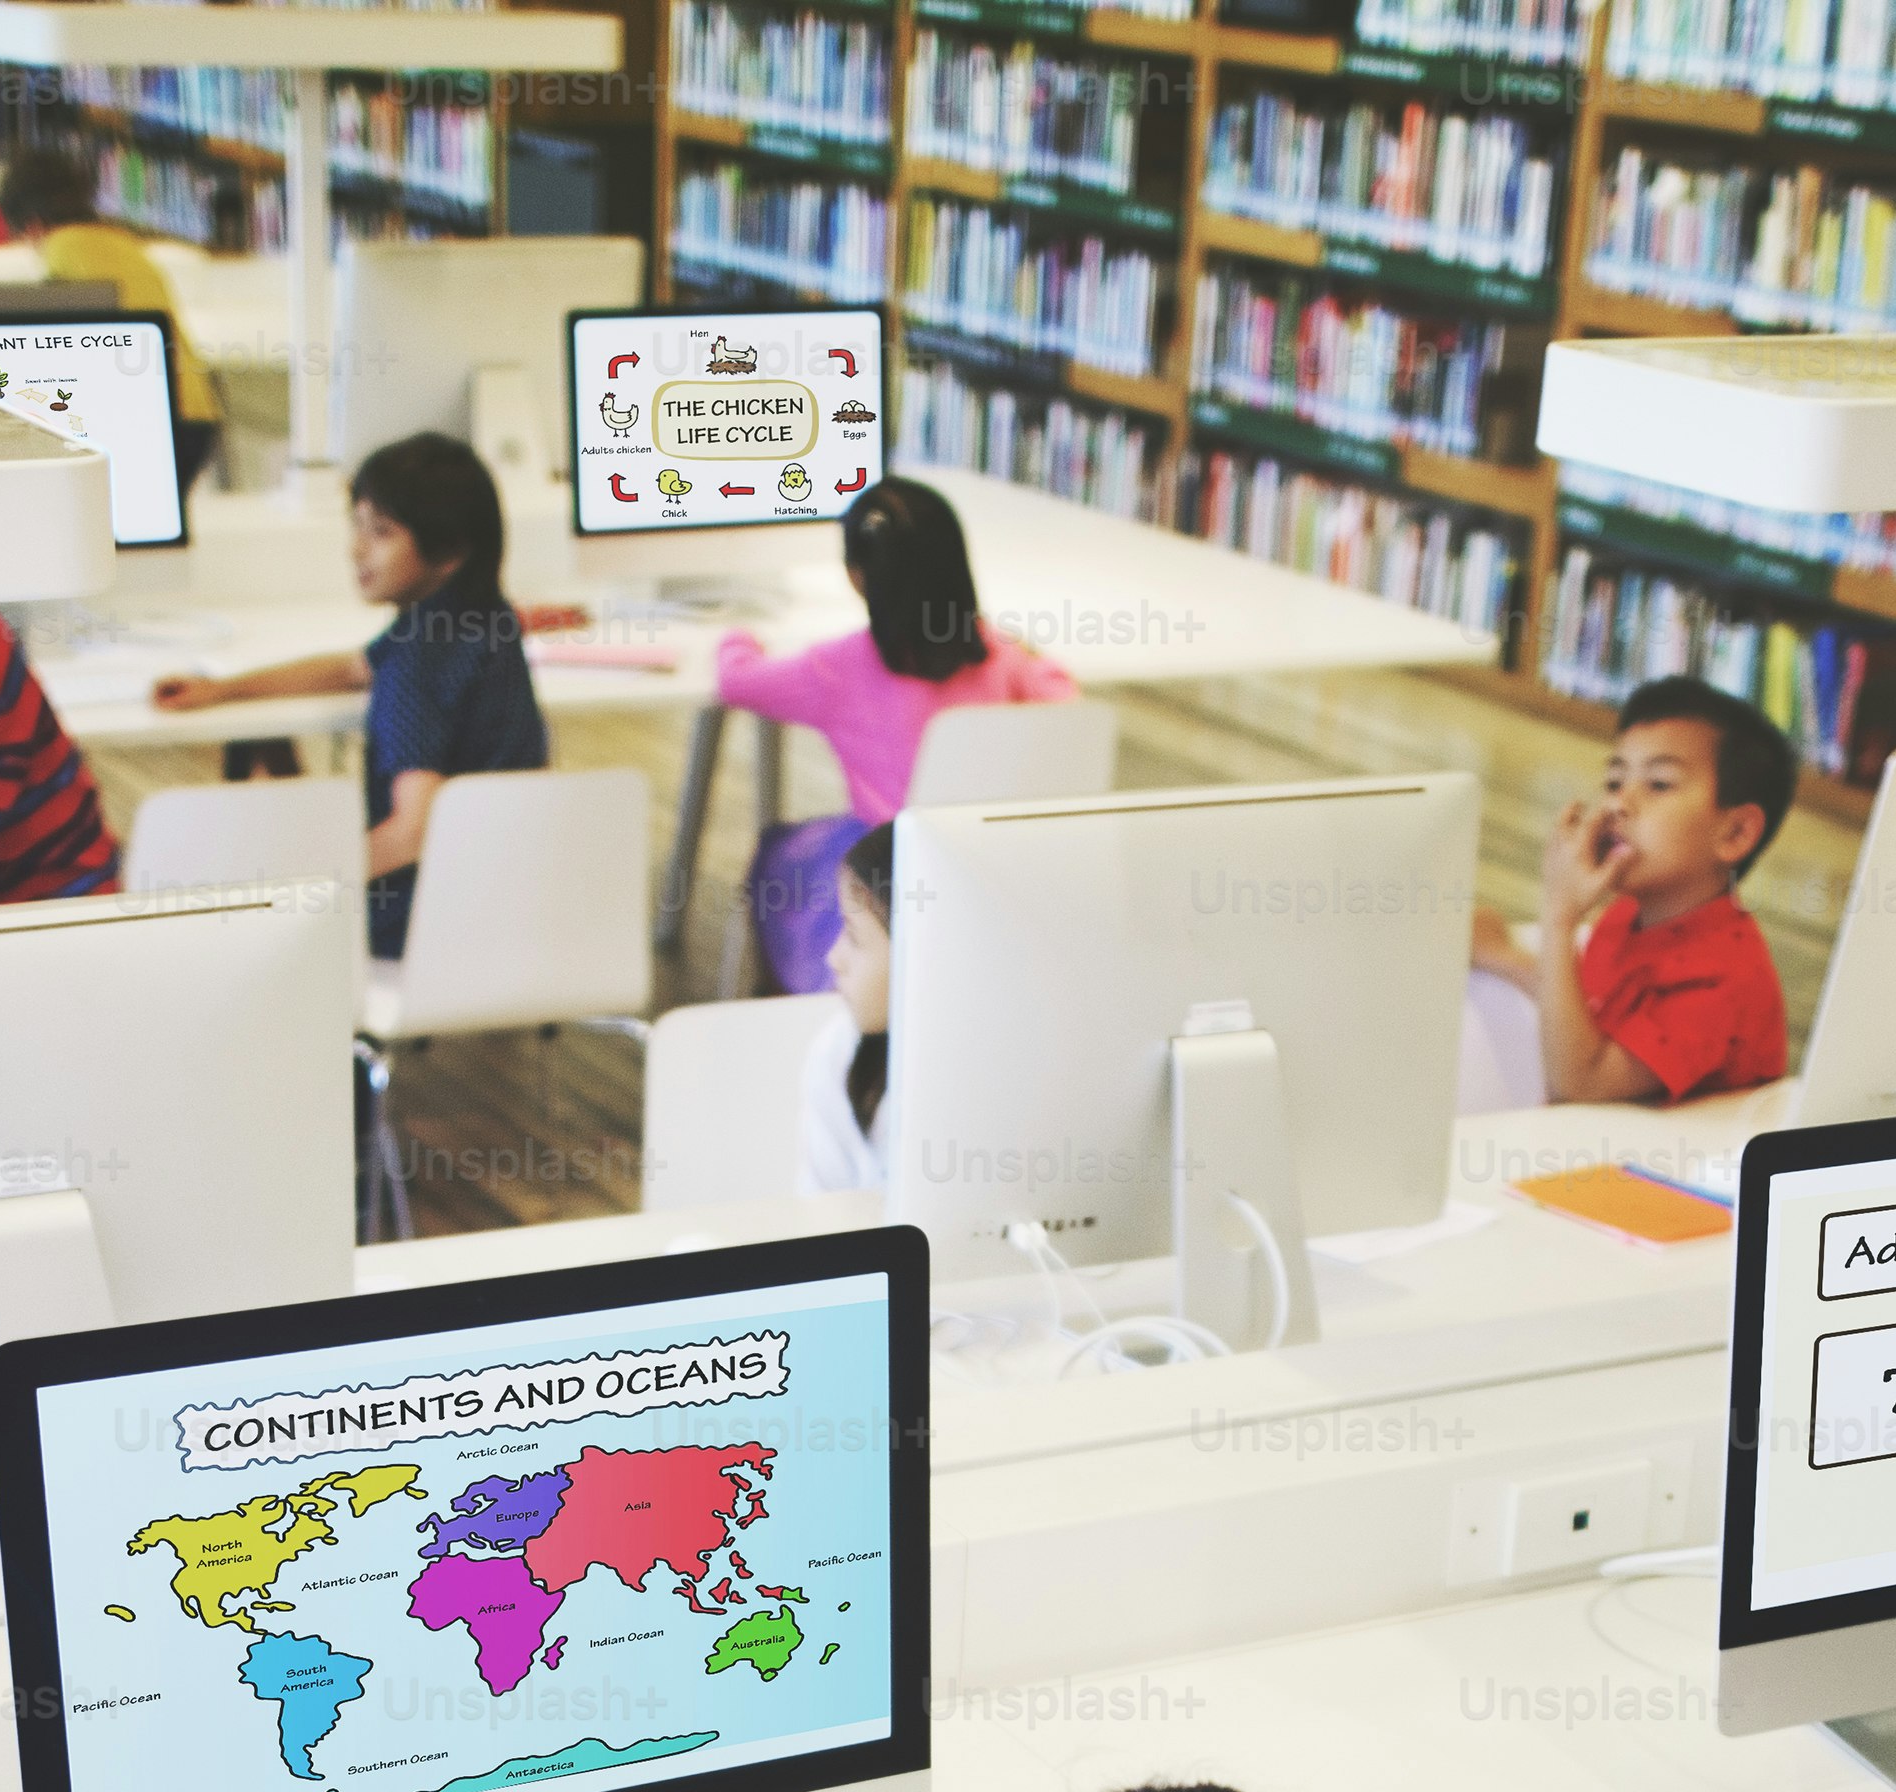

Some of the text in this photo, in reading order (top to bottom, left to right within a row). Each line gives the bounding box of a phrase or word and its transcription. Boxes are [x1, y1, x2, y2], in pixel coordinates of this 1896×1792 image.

[35, 336, 73, 349] LIFE
[81, 334, 133, 348] CYCLE
[690, 330, 709, 338] Hen
[663, 397, 804, 417] THE CHICKEN
[677, 425, 793, 444] LIFE CYCLE
[843, 430, 867, 440] Eggs
[581, 445, 652, 455] Adults chicken
[661, 509, 688, 518] Chick
[774, 506, 818, 516] Hatching
[204, 1352, 767, 1453] CONTINENTS AND OCEANS
[456, 1440, 539, 1461] Arctic Ocean
[624, 1501, 652, 1512] Asia
[496, 1508, 540, 1524] Europe
[202, 1540, 243, 1553] North
[196, 1553, 253, 1569] America
[808, 1550, 882, 1569] Pacific Ocean
[302, 1569, 398, 1592] Atlantic Ocean
[477, 1601, 517, 1615] Africa
[590, 1628, 664, 1648] Indian Ocean
[731, 1633, 786, 1651] Australia
[286, 1665, 327, 1678] South
[281, 1678, 334, 1693] America
[73, 1692, 161, 1713] Pacific Ocean
[347, 1750, 449, 1775] Southern Ocean
[506, 1761, 574, 1780] Antaectica
